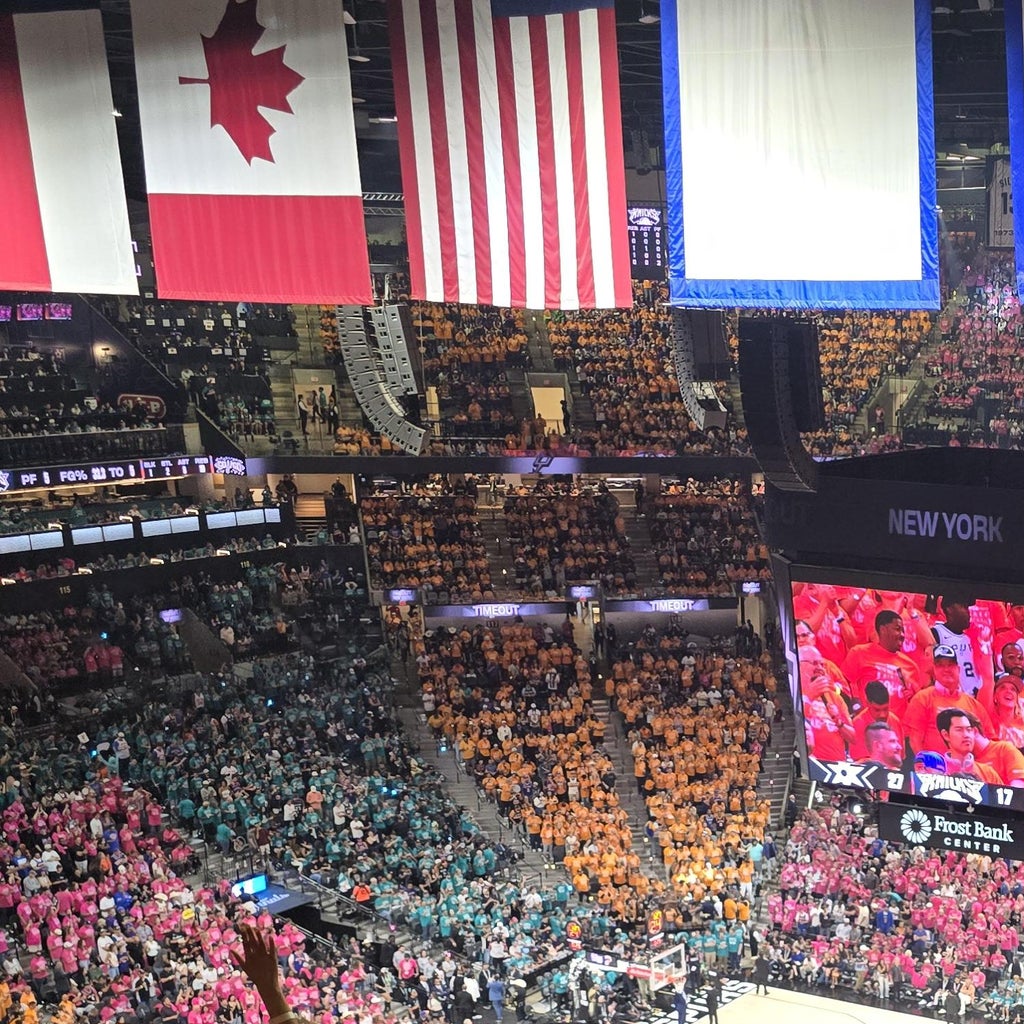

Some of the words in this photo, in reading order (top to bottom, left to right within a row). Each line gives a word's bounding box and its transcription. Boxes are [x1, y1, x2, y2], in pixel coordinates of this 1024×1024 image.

[21, 473, 37, 485] PF
[60, 470, 88, 482] FG%
[109, 467, 124, 478] TO
[889, 508, 939, 537] NEW
[942, 512, 1003, 542] YORK
[59, 585, 71, 594] 115
[472, 604, 520, 617] TIMEOUT
[650, 600, 694, 612] TIMEOUT
[963, 662, 974, 677] 2
[917, 773, 988, 802] KNICKS
[996, 787, 1014, 806] 17
[934, 815, 971, 835] Frost
[974, 821, 1014, 842] Bank
[944, 836, 1000, 853] CENTER
